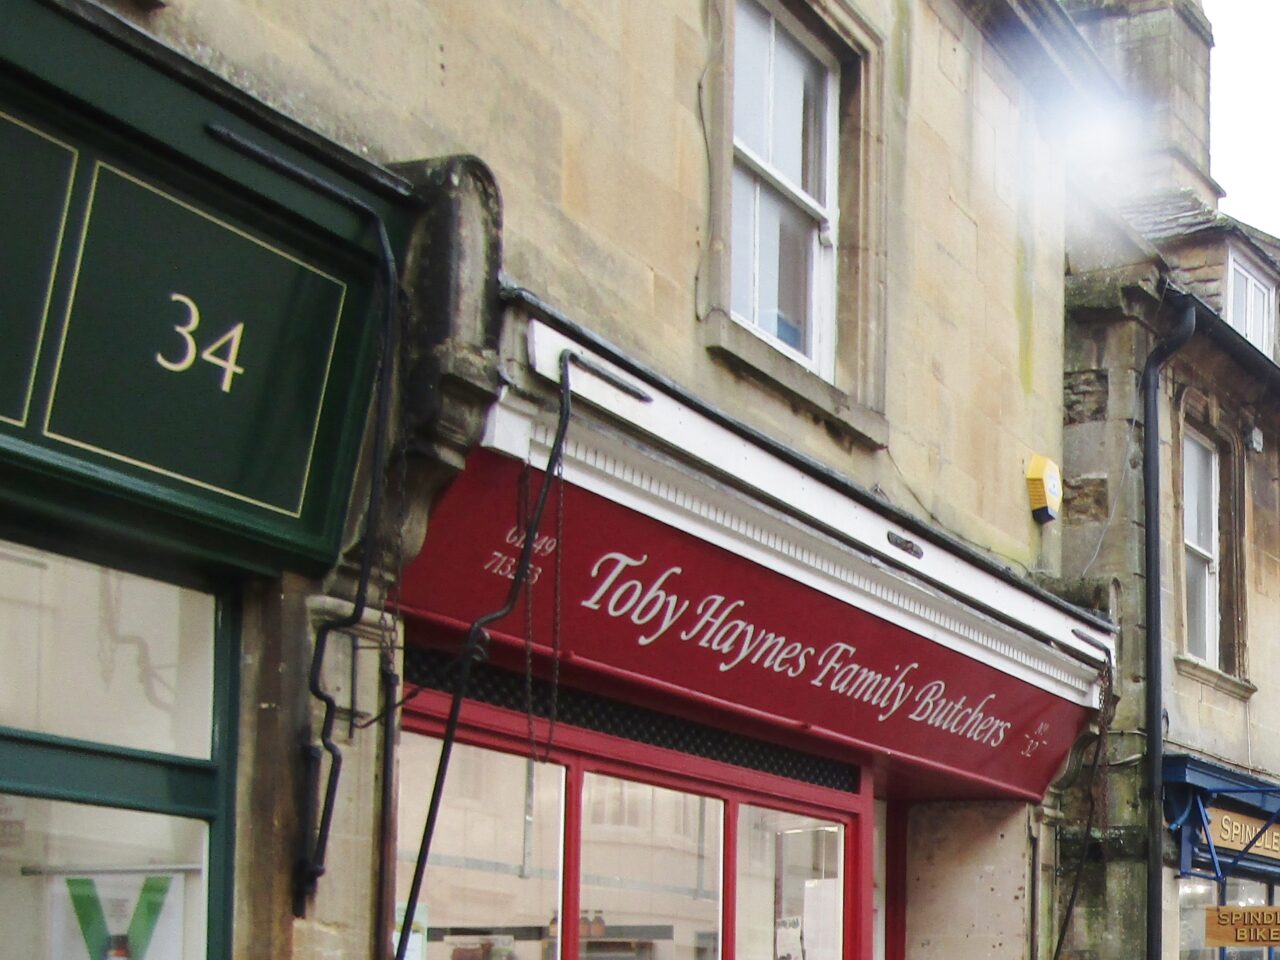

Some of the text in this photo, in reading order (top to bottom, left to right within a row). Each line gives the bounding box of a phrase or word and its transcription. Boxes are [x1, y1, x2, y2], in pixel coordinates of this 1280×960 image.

[156, 292, 245, 393] 34
[506, 526, 557, 556] 0149
[581, 552, 1011, 748] Toby Haynes Family Butchers
